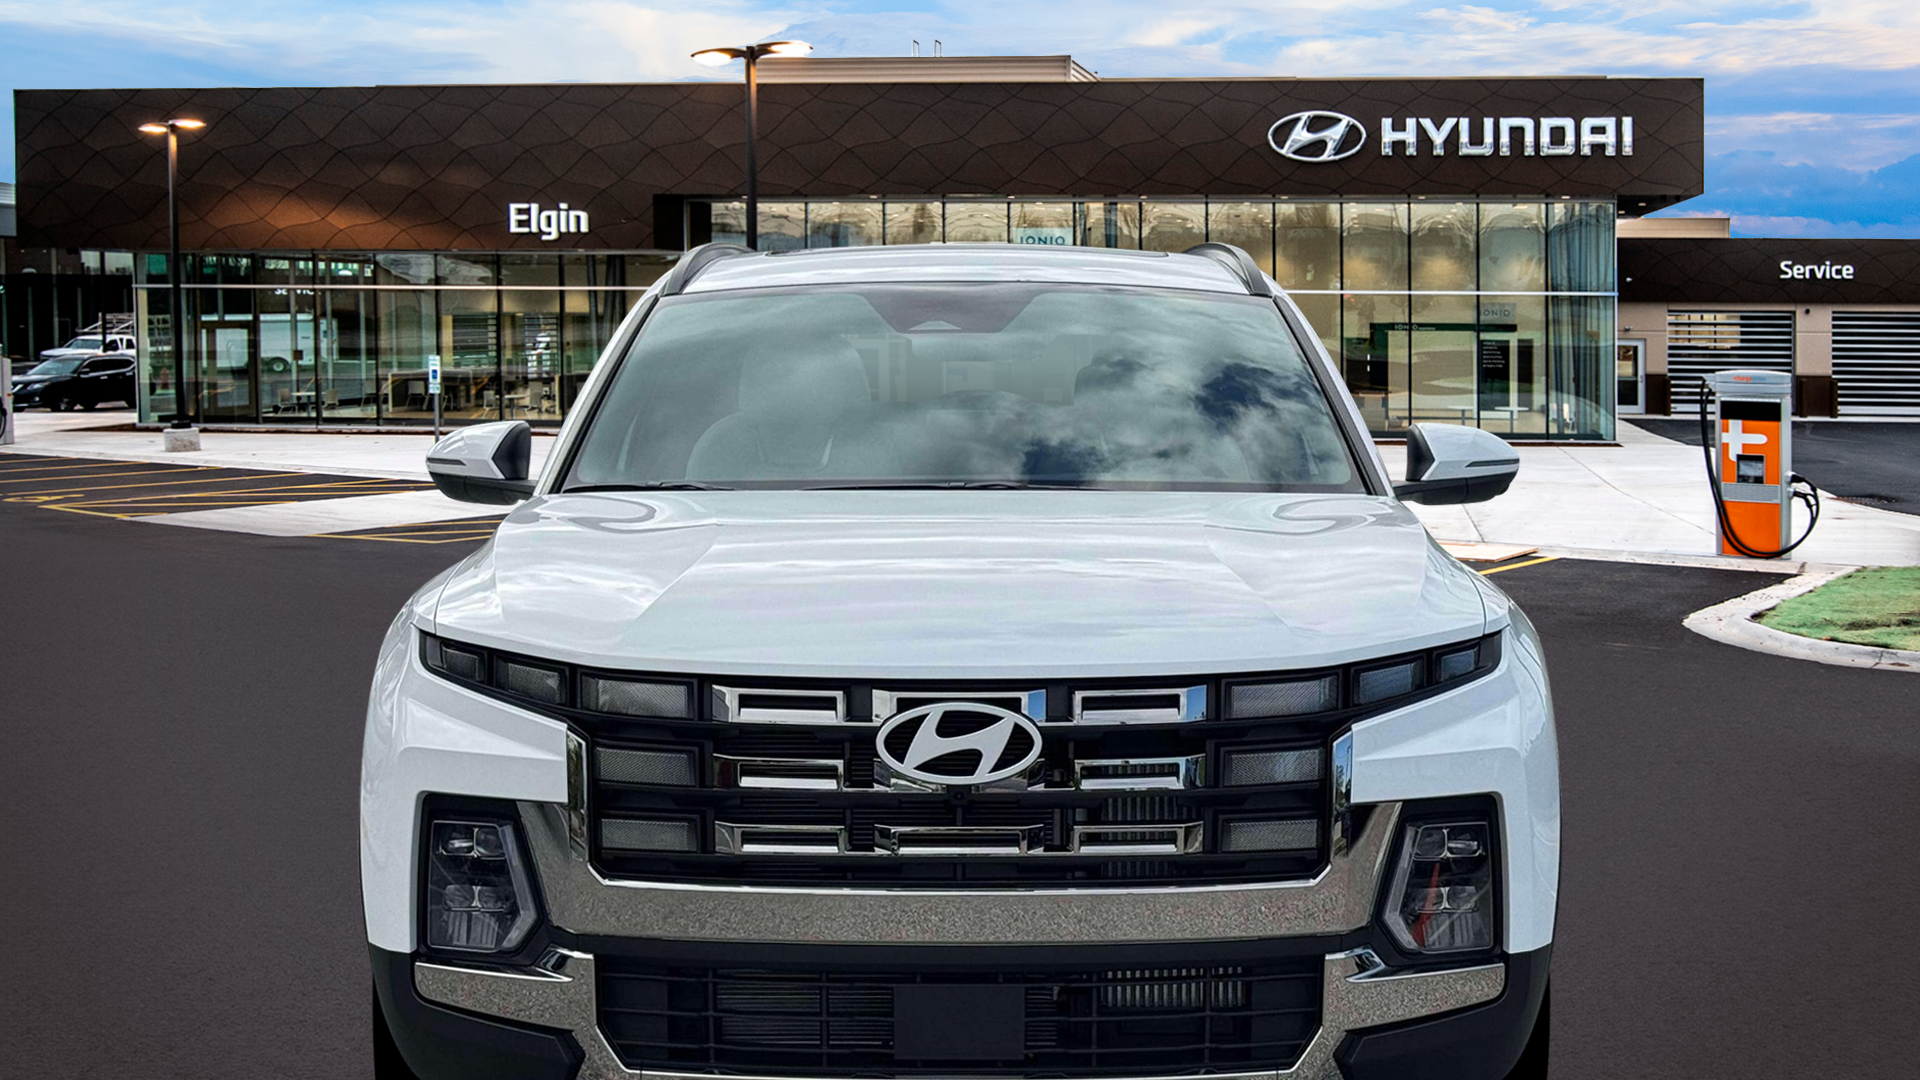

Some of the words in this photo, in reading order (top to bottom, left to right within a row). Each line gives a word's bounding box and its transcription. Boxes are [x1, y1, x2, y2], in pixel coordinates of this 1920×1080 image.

[1381, 117, 1633, 156] HYUNDAI
[509, 203, 589, 240] Elgin
[1779, 260, 1854, 279] Service
